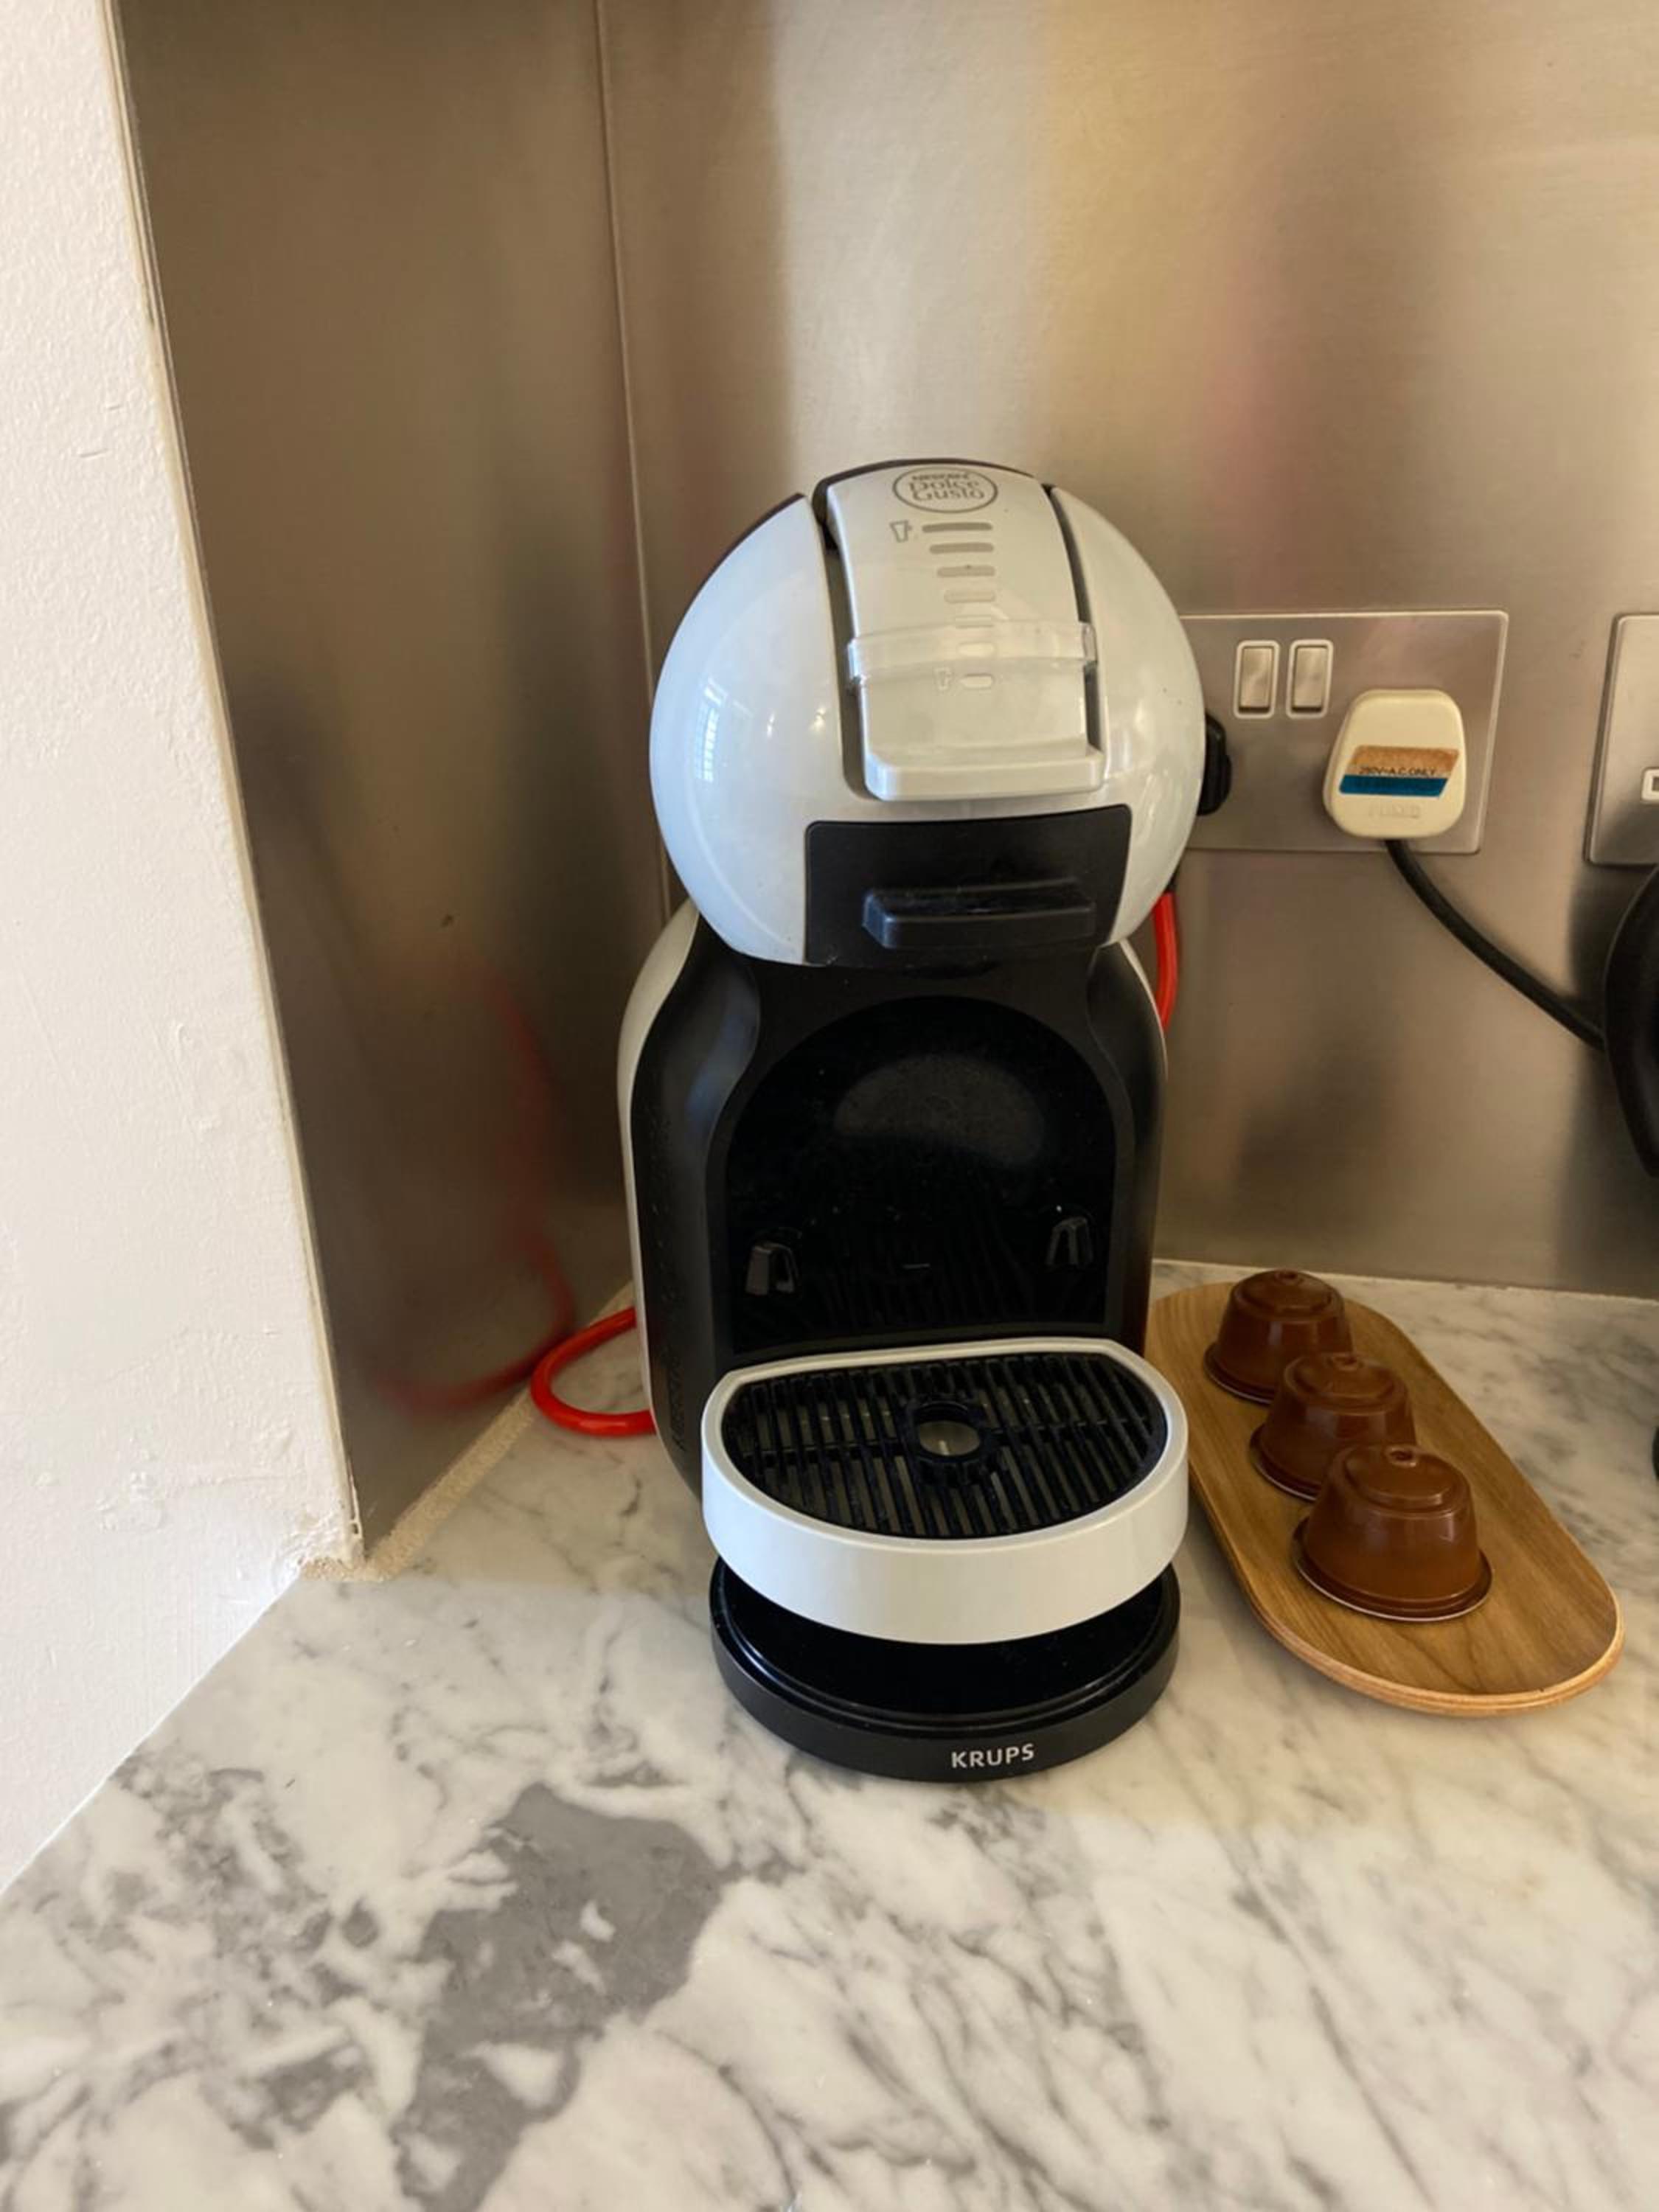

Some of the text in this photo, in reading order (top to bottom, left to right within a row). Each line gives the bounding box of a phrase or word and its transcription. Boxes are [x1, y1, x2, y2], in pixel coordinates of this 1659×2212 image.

[908, 478, 979, 491] Dolce
[912, 487, 985, 501] Gusto
[951, 1743, 1034, 1768] KRUPS
